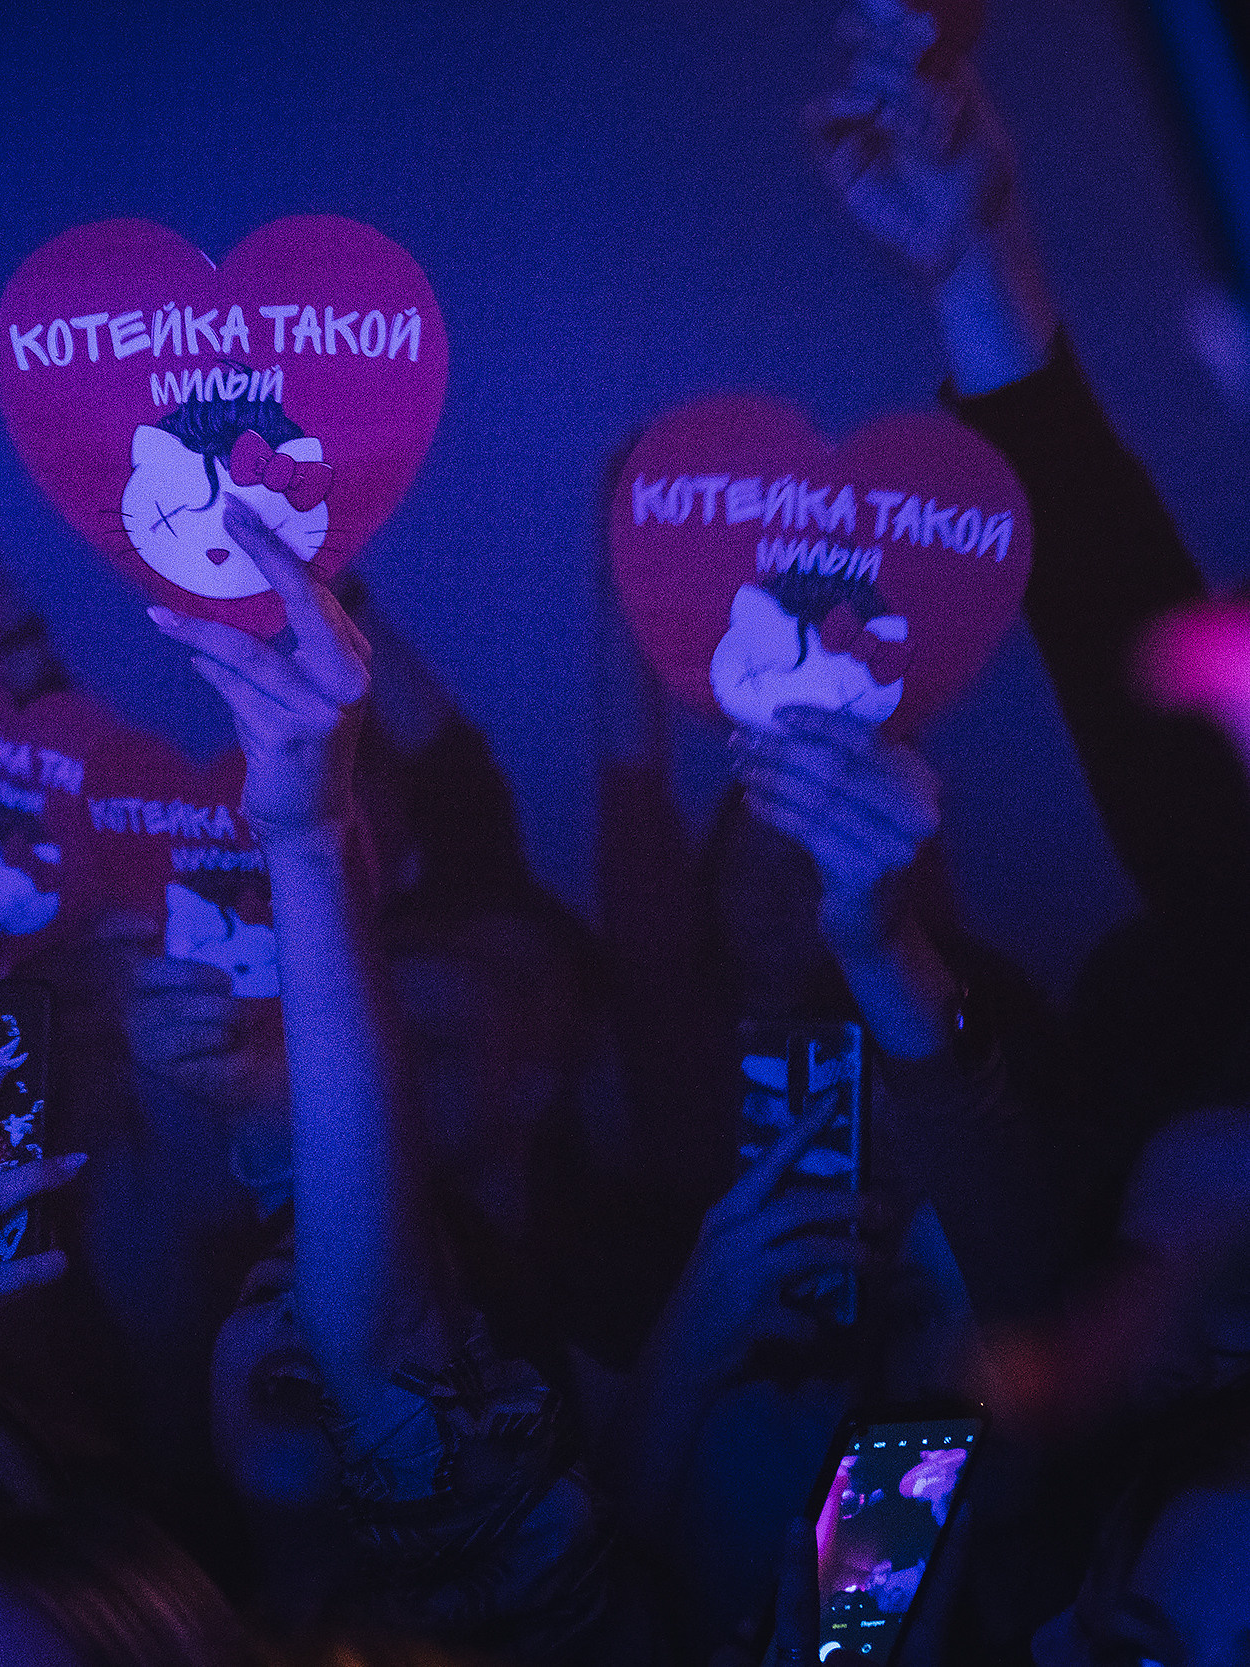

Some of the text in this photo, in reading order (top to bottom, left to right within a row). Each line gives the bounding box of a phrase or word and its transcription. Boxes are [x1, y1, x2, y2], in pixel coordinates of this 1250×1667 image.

[9, 302, 422, 371] КОТЕЙКА ТАКОЙ
[150, 365, 284, 406] МИЛЫЙ
[632, 473, 1014, 563] КОТЕЙКА ТАКОЙ
